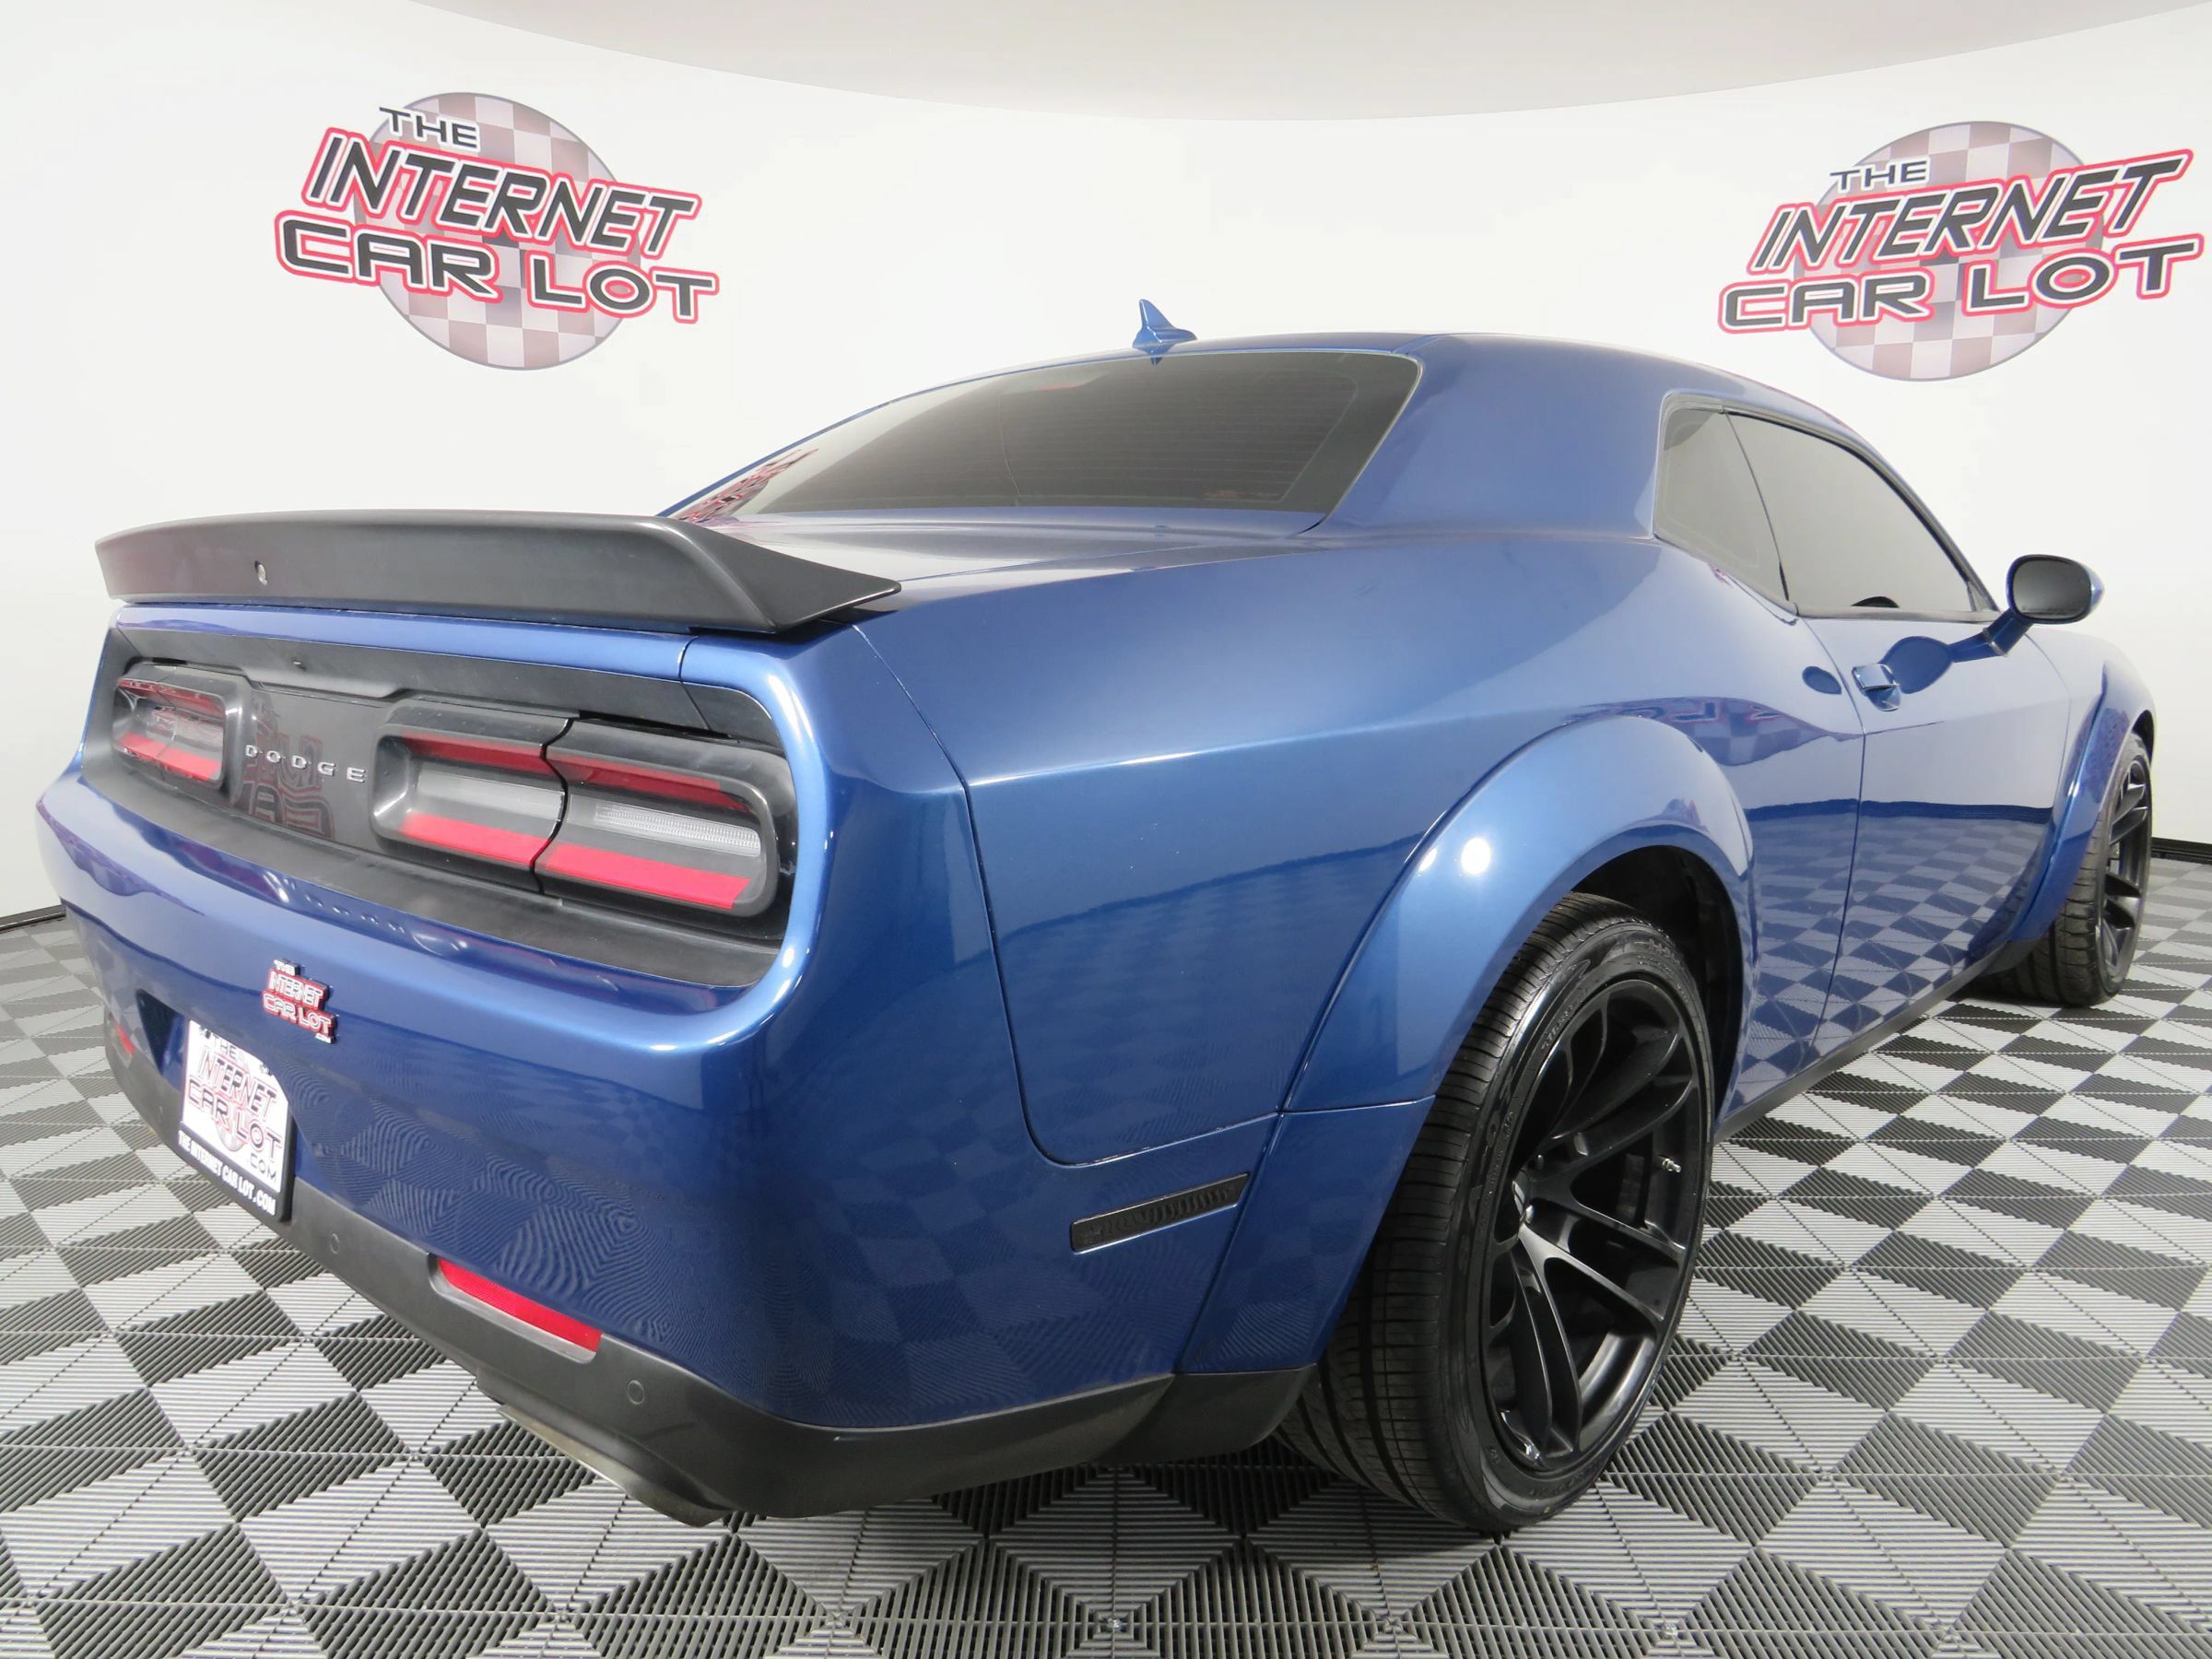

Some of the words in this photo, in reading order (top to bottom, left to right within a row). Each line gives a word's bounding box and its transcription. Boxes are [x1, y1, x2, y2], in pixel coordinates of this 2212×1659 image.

[379, 105, 480, 151] THE
[303, 128, 701, 259] INTERNET
[1830, 158, 1930, 193] THE
[1747, 149, 2193, 275] INTERNET
[276, 211, 502, 302] CAR
[525, 251, 719, 324] LOT
[1719, 267, 1935, 333] CAR
[1962, 234, 2204, 316] LOT
[245, 744, 366, 782] DODGE
[263, 991, 298, 1023] CAR
[298, 1006, 332, 1035] LOT
[268, 969, 325, 1010] INTERNET
[212, 1031, 237, 1060] THE
[187, 1076, 231, 1132] CAR
[235, 1108, 283, 1162] LOT
[196, 1046, 278, 1121] INTERNET
[178, 1129, 192, 1153] THE
[190, 1139, 223, 1177] INTERNET
[222, 1165, 239, 1189] CAR
[238, 1176, 255, 1200] LOT
